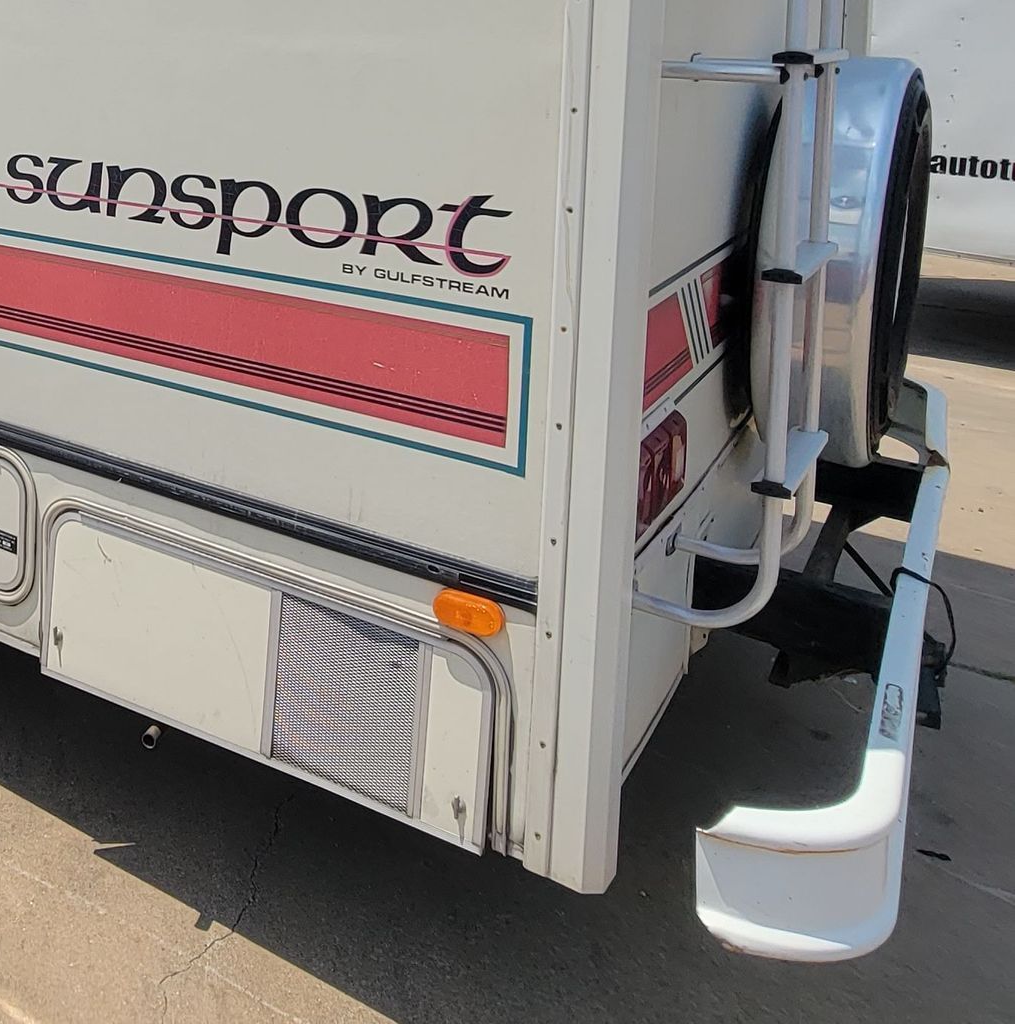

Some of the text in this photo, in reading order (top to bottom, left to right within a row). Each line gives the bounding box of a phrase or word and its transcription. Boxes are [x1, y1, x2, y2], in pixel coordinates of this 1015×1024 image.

[930, 155, 1015, 182] autot
[342, 263, 510, 300] BY GULFSTREAM
